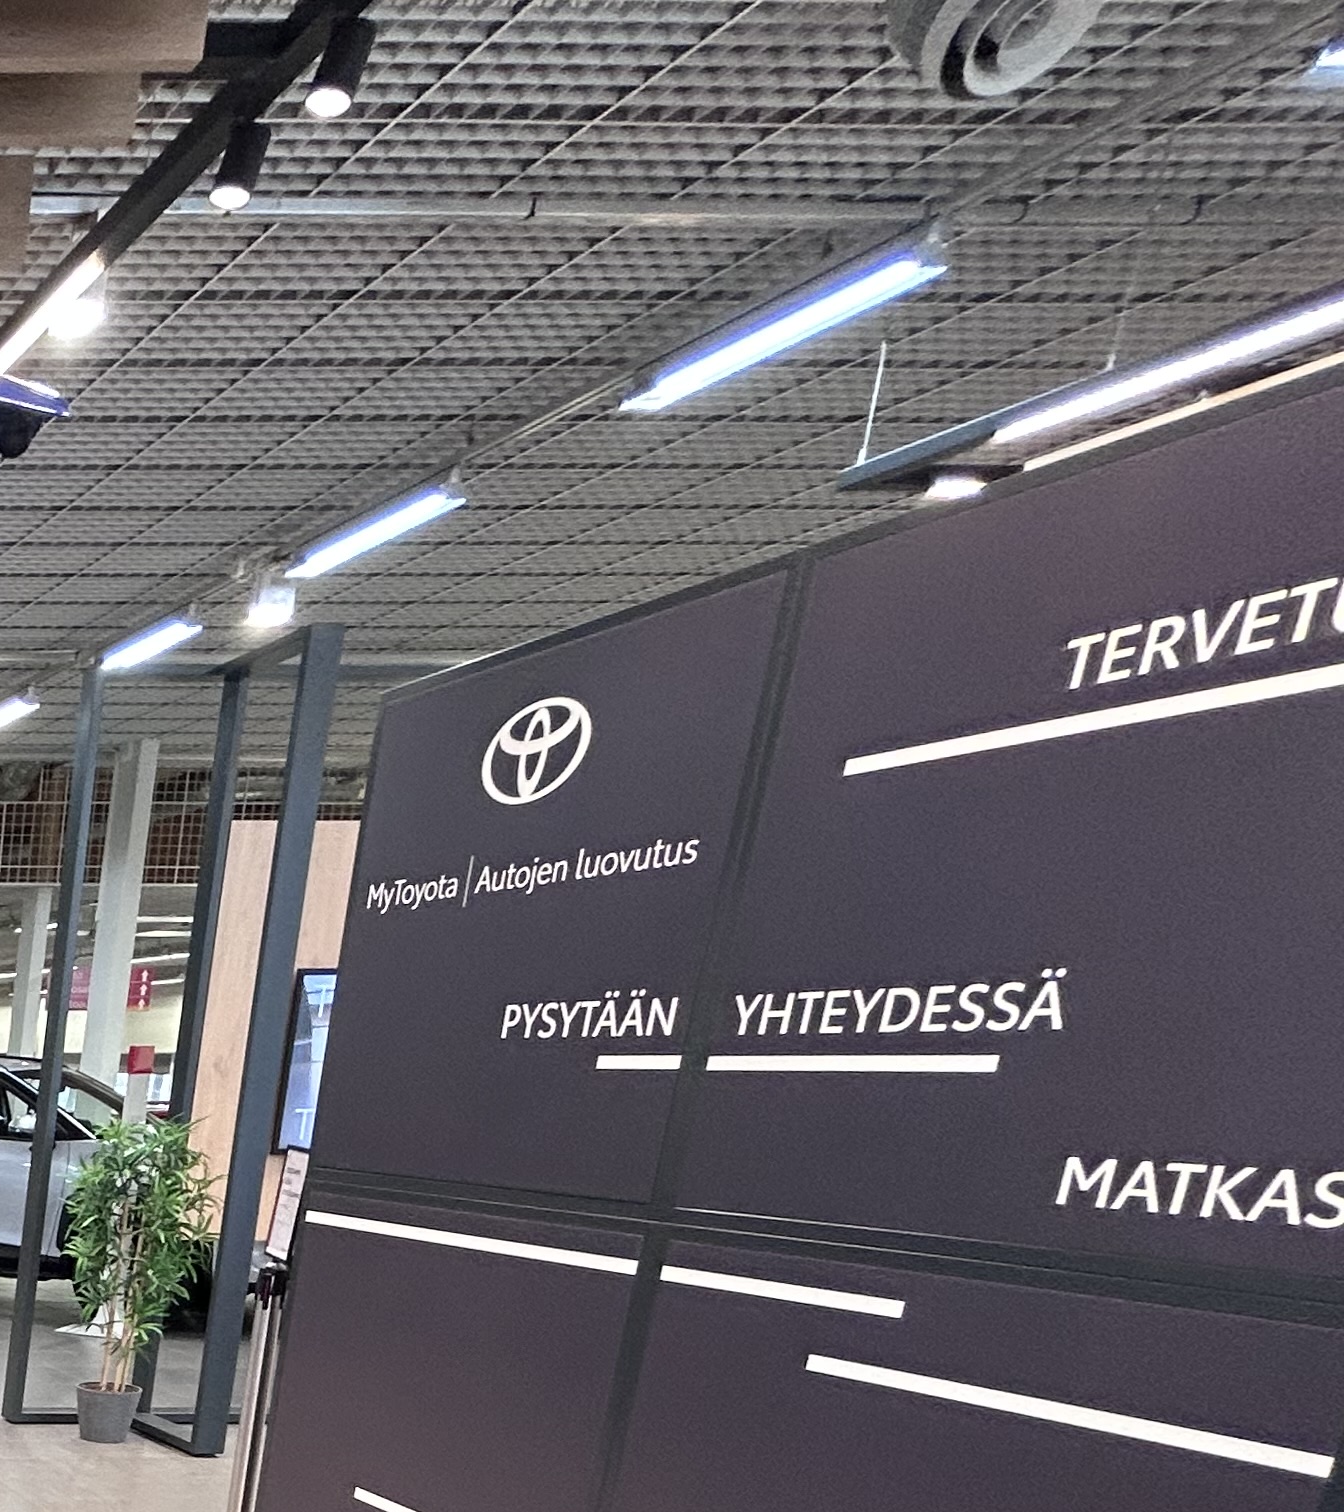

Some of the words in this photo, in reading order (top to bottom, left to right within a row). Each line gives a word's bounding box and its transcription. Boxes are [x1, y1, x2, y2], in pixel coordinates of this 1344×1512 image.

[366, 874, 459, 914] MyToyota
[474, 857, 568, 894] Autojen
[574, 839, 700, 880] luovutus
[500, 989, 678, 1039] PYSYTÄÄN
[733, 967, 1067, 1036] YHTEYDESSÄ
